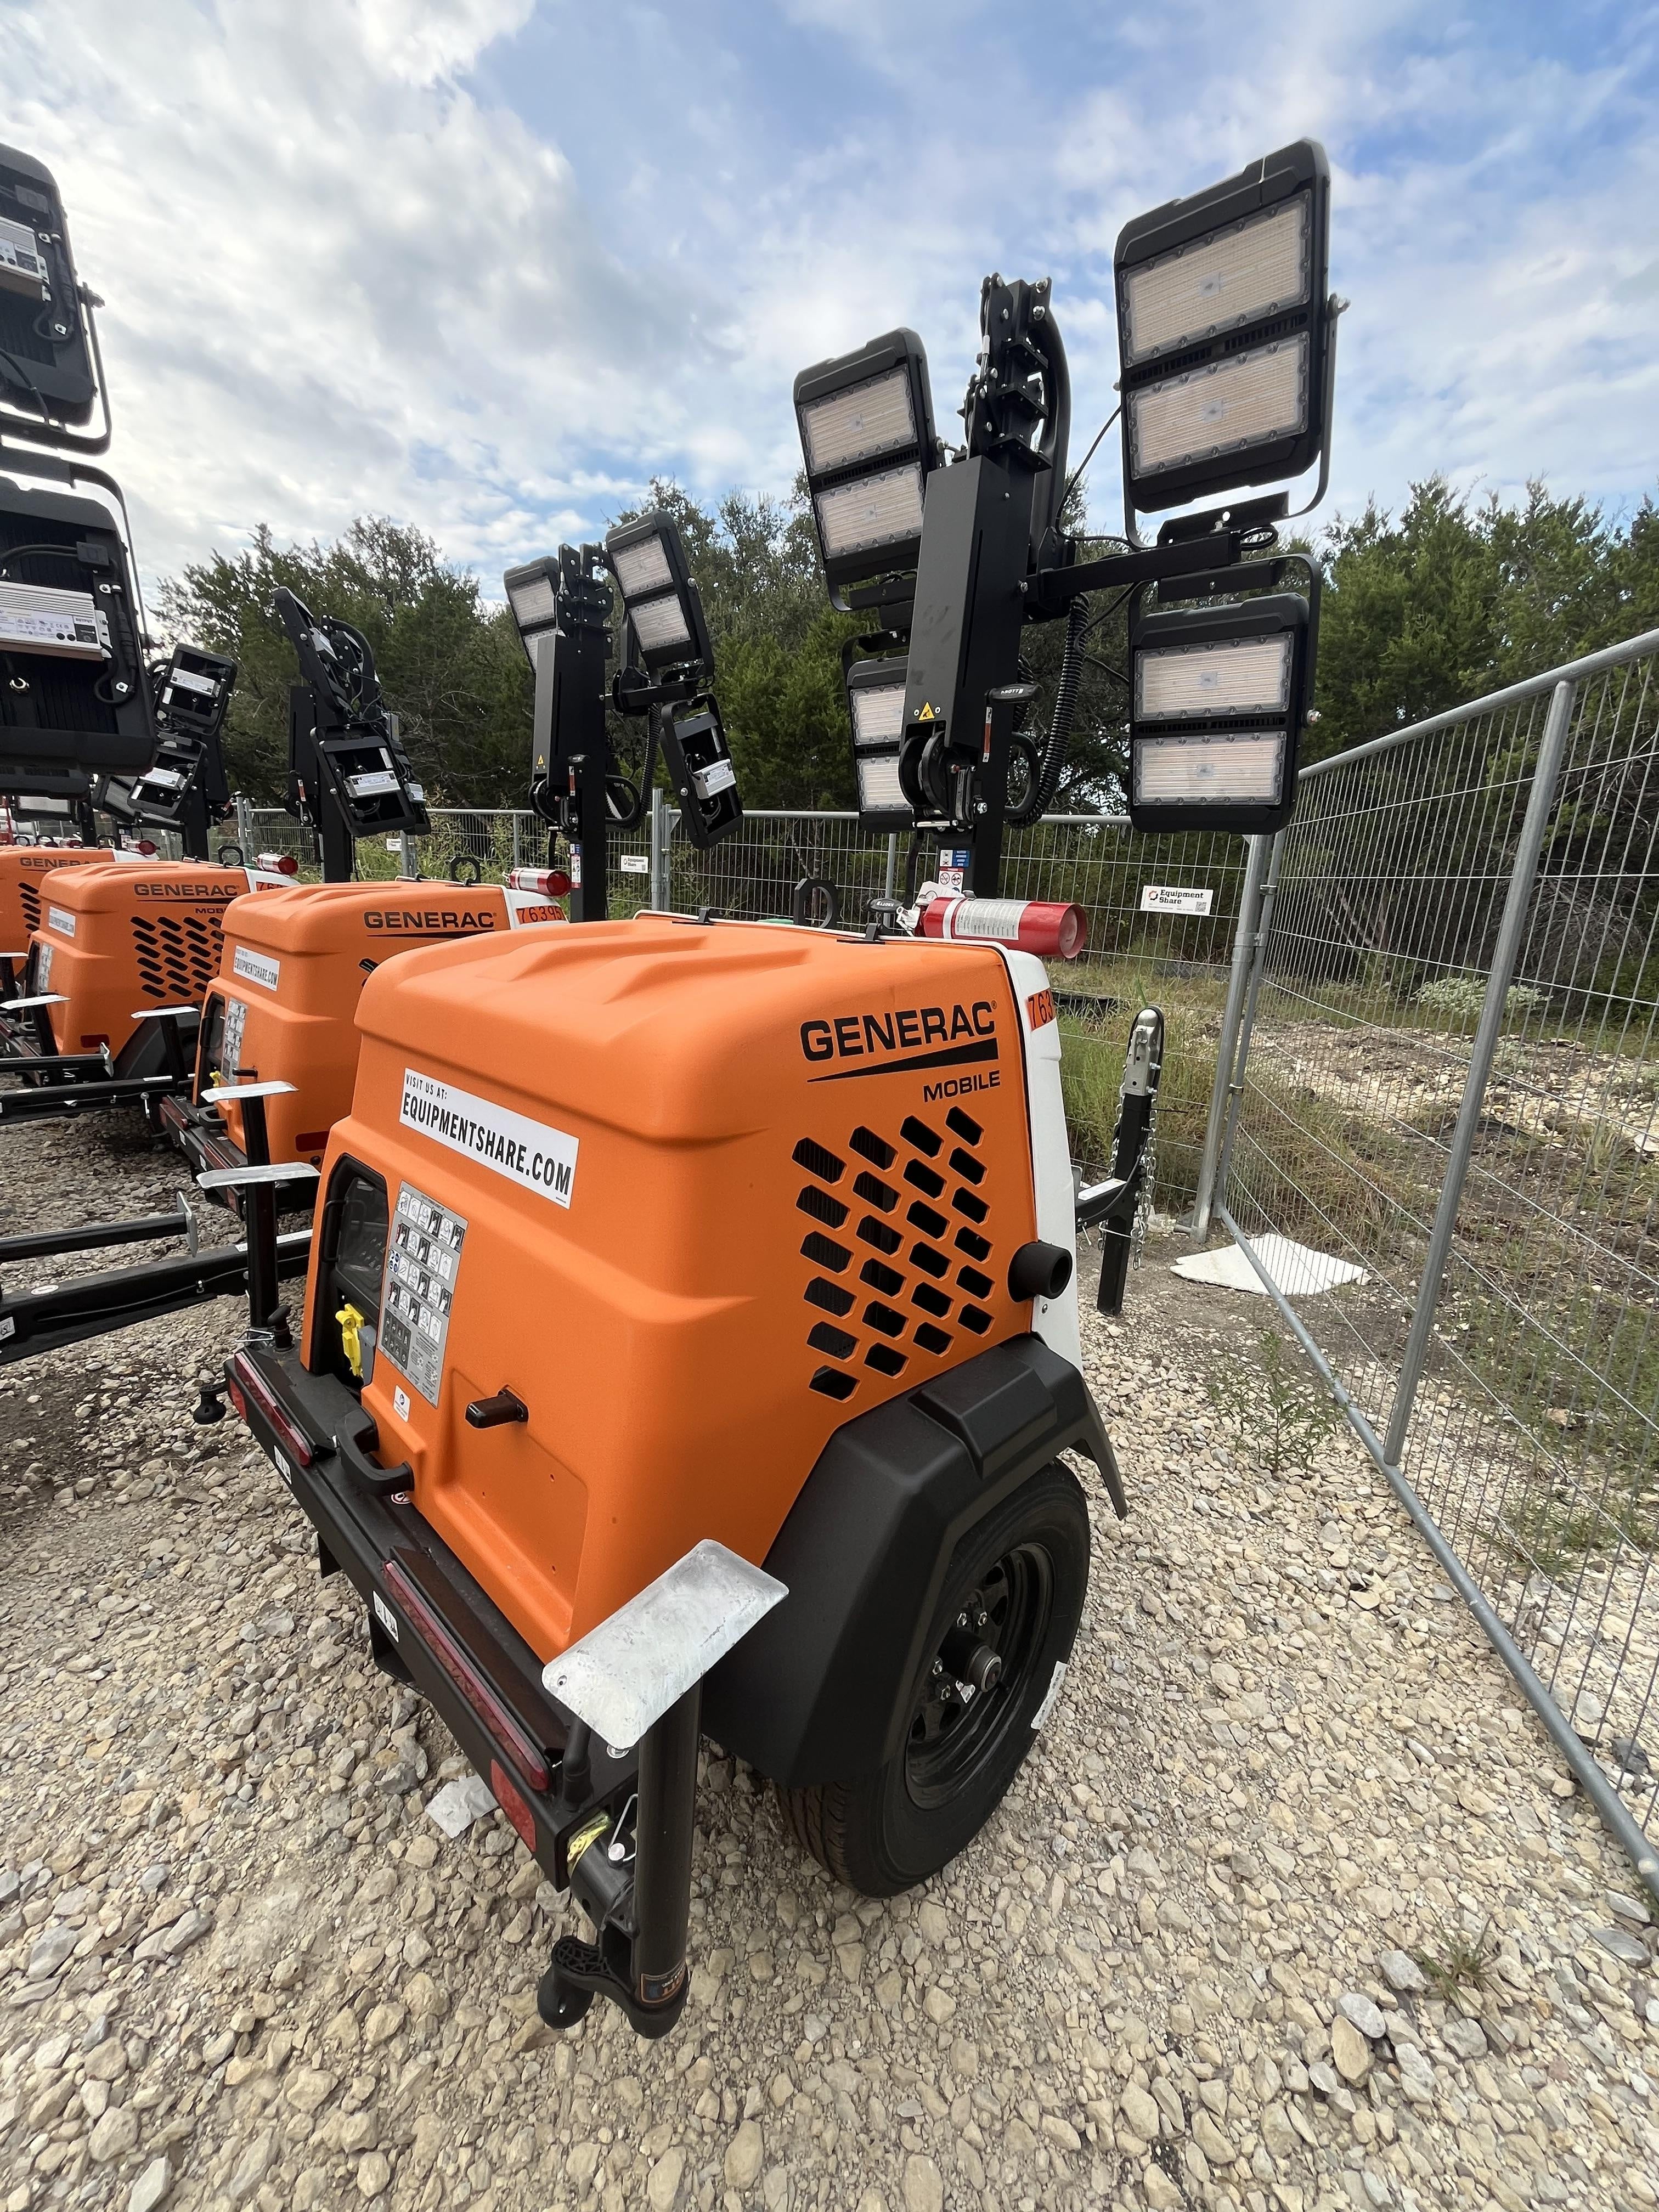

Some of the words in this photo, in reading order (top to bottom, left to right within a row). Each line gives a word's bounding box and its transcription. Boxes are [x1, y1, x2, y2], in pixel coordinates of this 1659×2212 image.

[20, 857, 90, 868] GENER
[134, 884, 238, 896] GENERAC
[1160, 889, 1204, 899] Equipment
[364, 912, 494, 928] GENERAC
[516, 906, 562, 923] 76395
[800, 1001, 995, 1062] GENERAC
[406, 1074, 424, 1091] VISIT
[426, 1082, 433, 1095] US
[437, 1087, 447, 1100] AT:
[923, 1070, 1001, 1103] MOBILE
[403, 1092, 572, 1195] EQUIPMENTSHARE.COM
